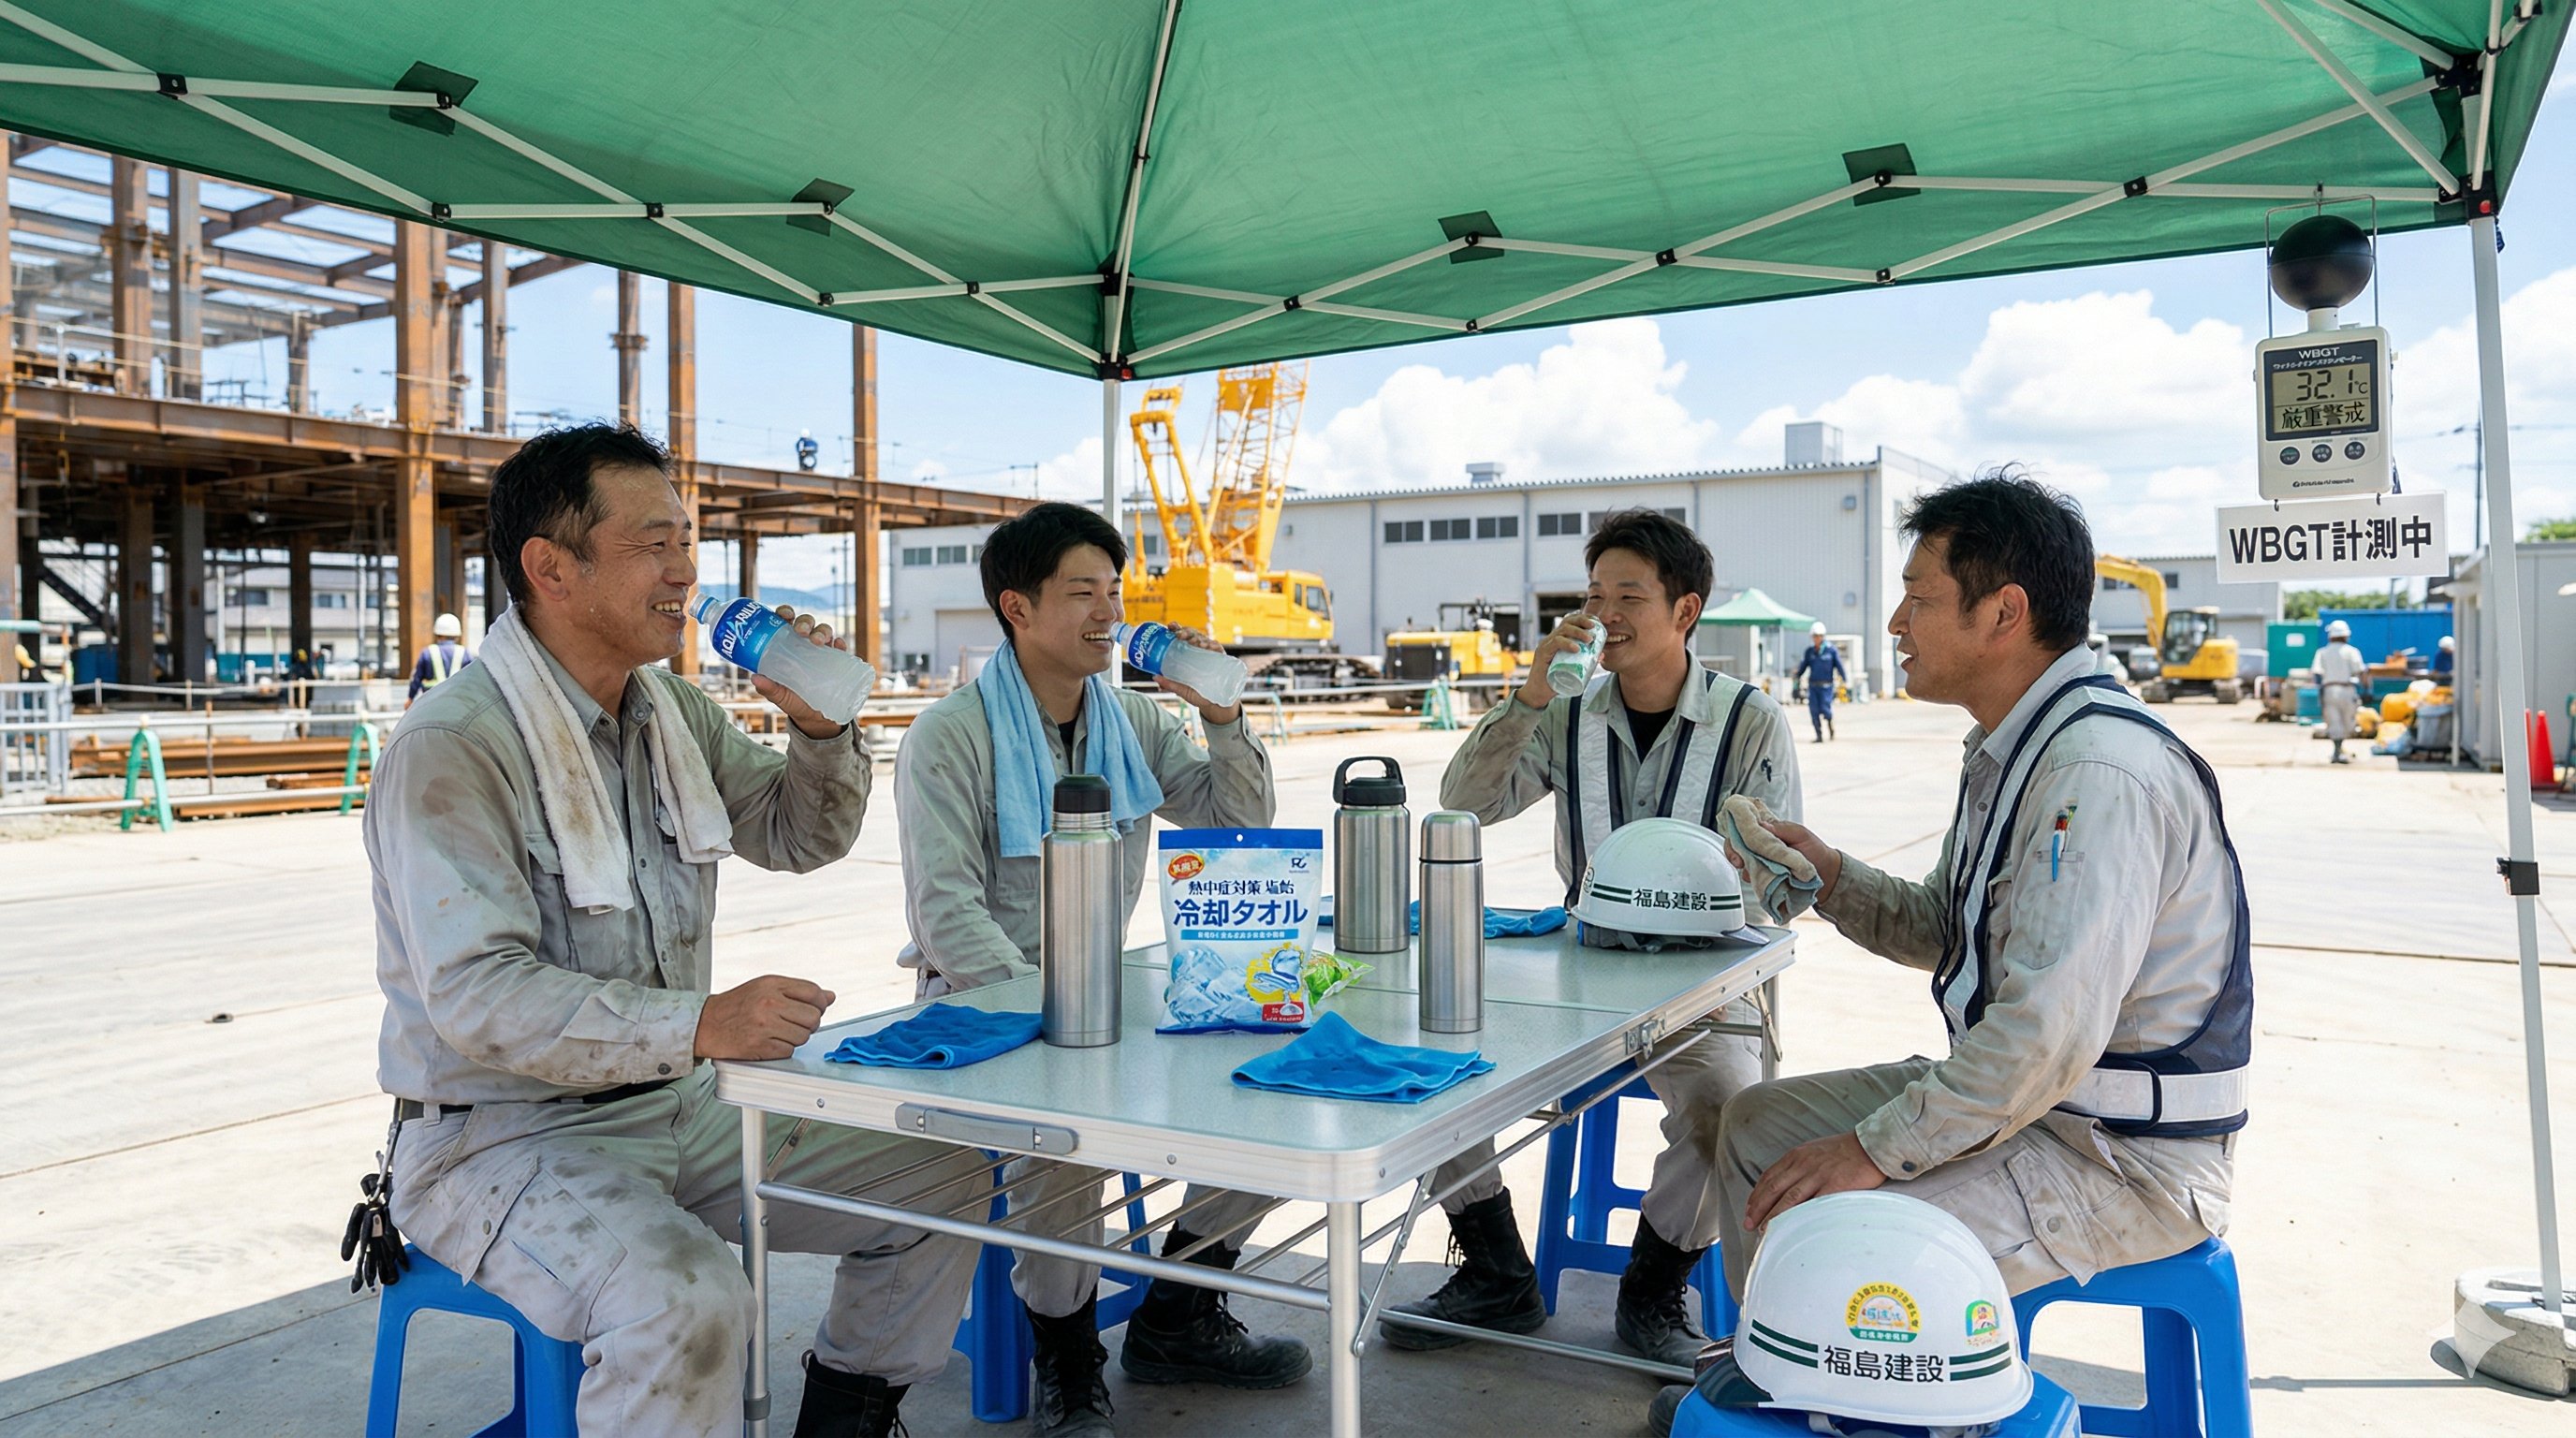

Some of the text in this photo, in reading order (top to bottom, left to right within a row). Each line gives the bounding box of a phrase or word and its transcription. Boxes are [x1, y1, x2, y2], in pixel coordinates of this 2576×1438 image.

[2298, 346, 2340, 360] WBGT
[2229, 515, 2433, 565] WBGT計測中
[1173, 898, 1309, 927] 冷却タオル
[1633, 888, 1708, 911] 福島建設
[1823, 1344, 1944, 1384] 福島建設
